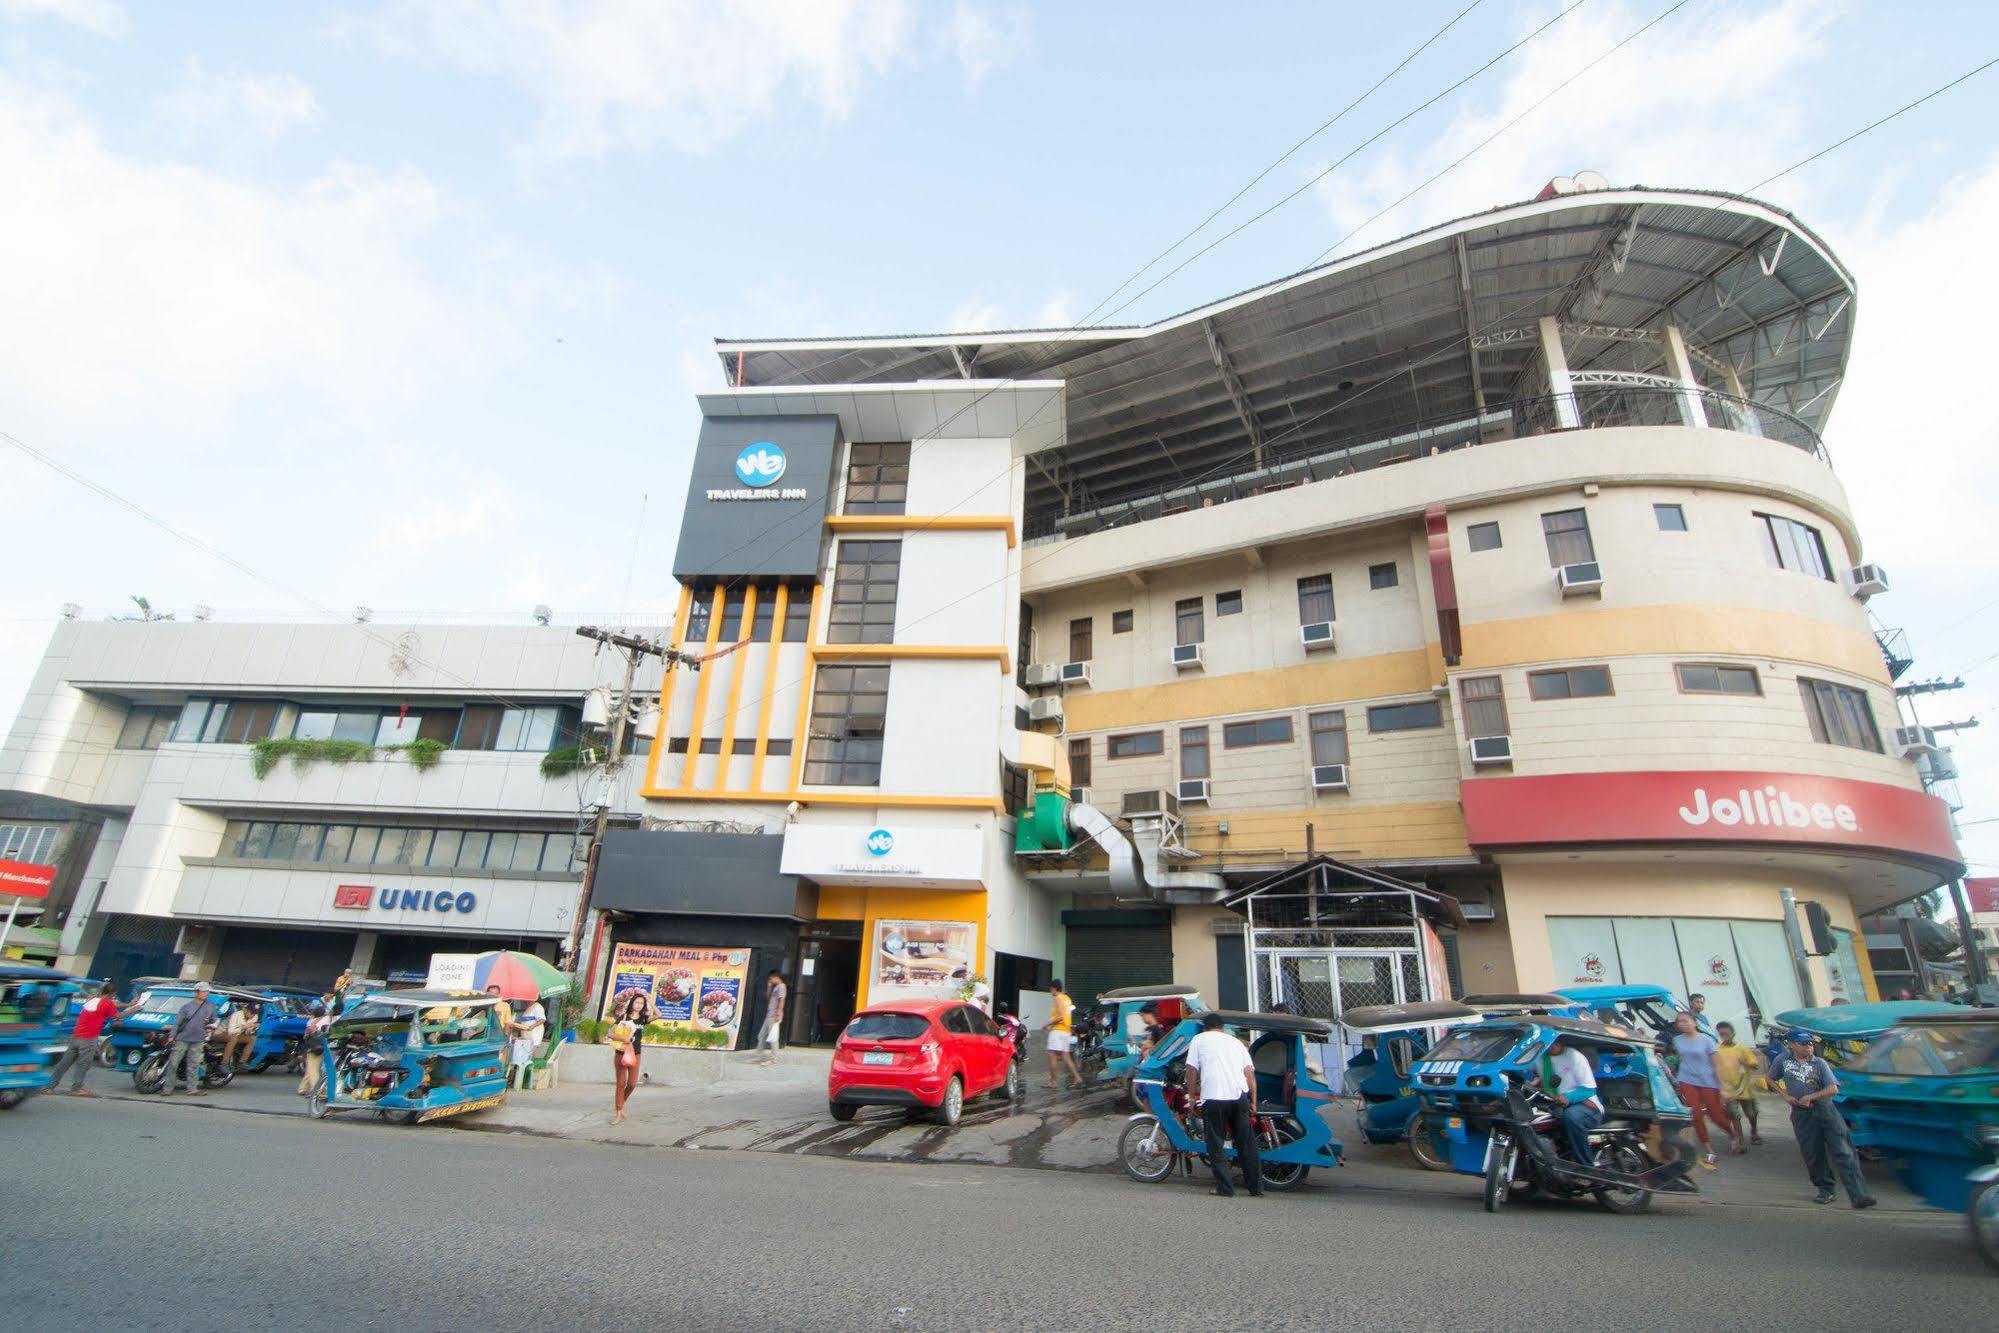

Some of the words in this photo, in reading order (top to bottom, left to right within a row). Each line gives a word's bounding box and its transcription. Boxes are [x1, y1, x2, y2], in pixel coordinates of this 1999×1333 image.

[706, 489, 780, 500] TRAVELERS
[781, 489, 807, 499] INN
[1679, 786, 1858, 831] Jollibee
[379, 888, 476, 914] UNICO
[618, 948, 676, 960] BARKADAHAN
[679, 951, 701, 961] MEAL
[712, 952, 728, 964] Php
